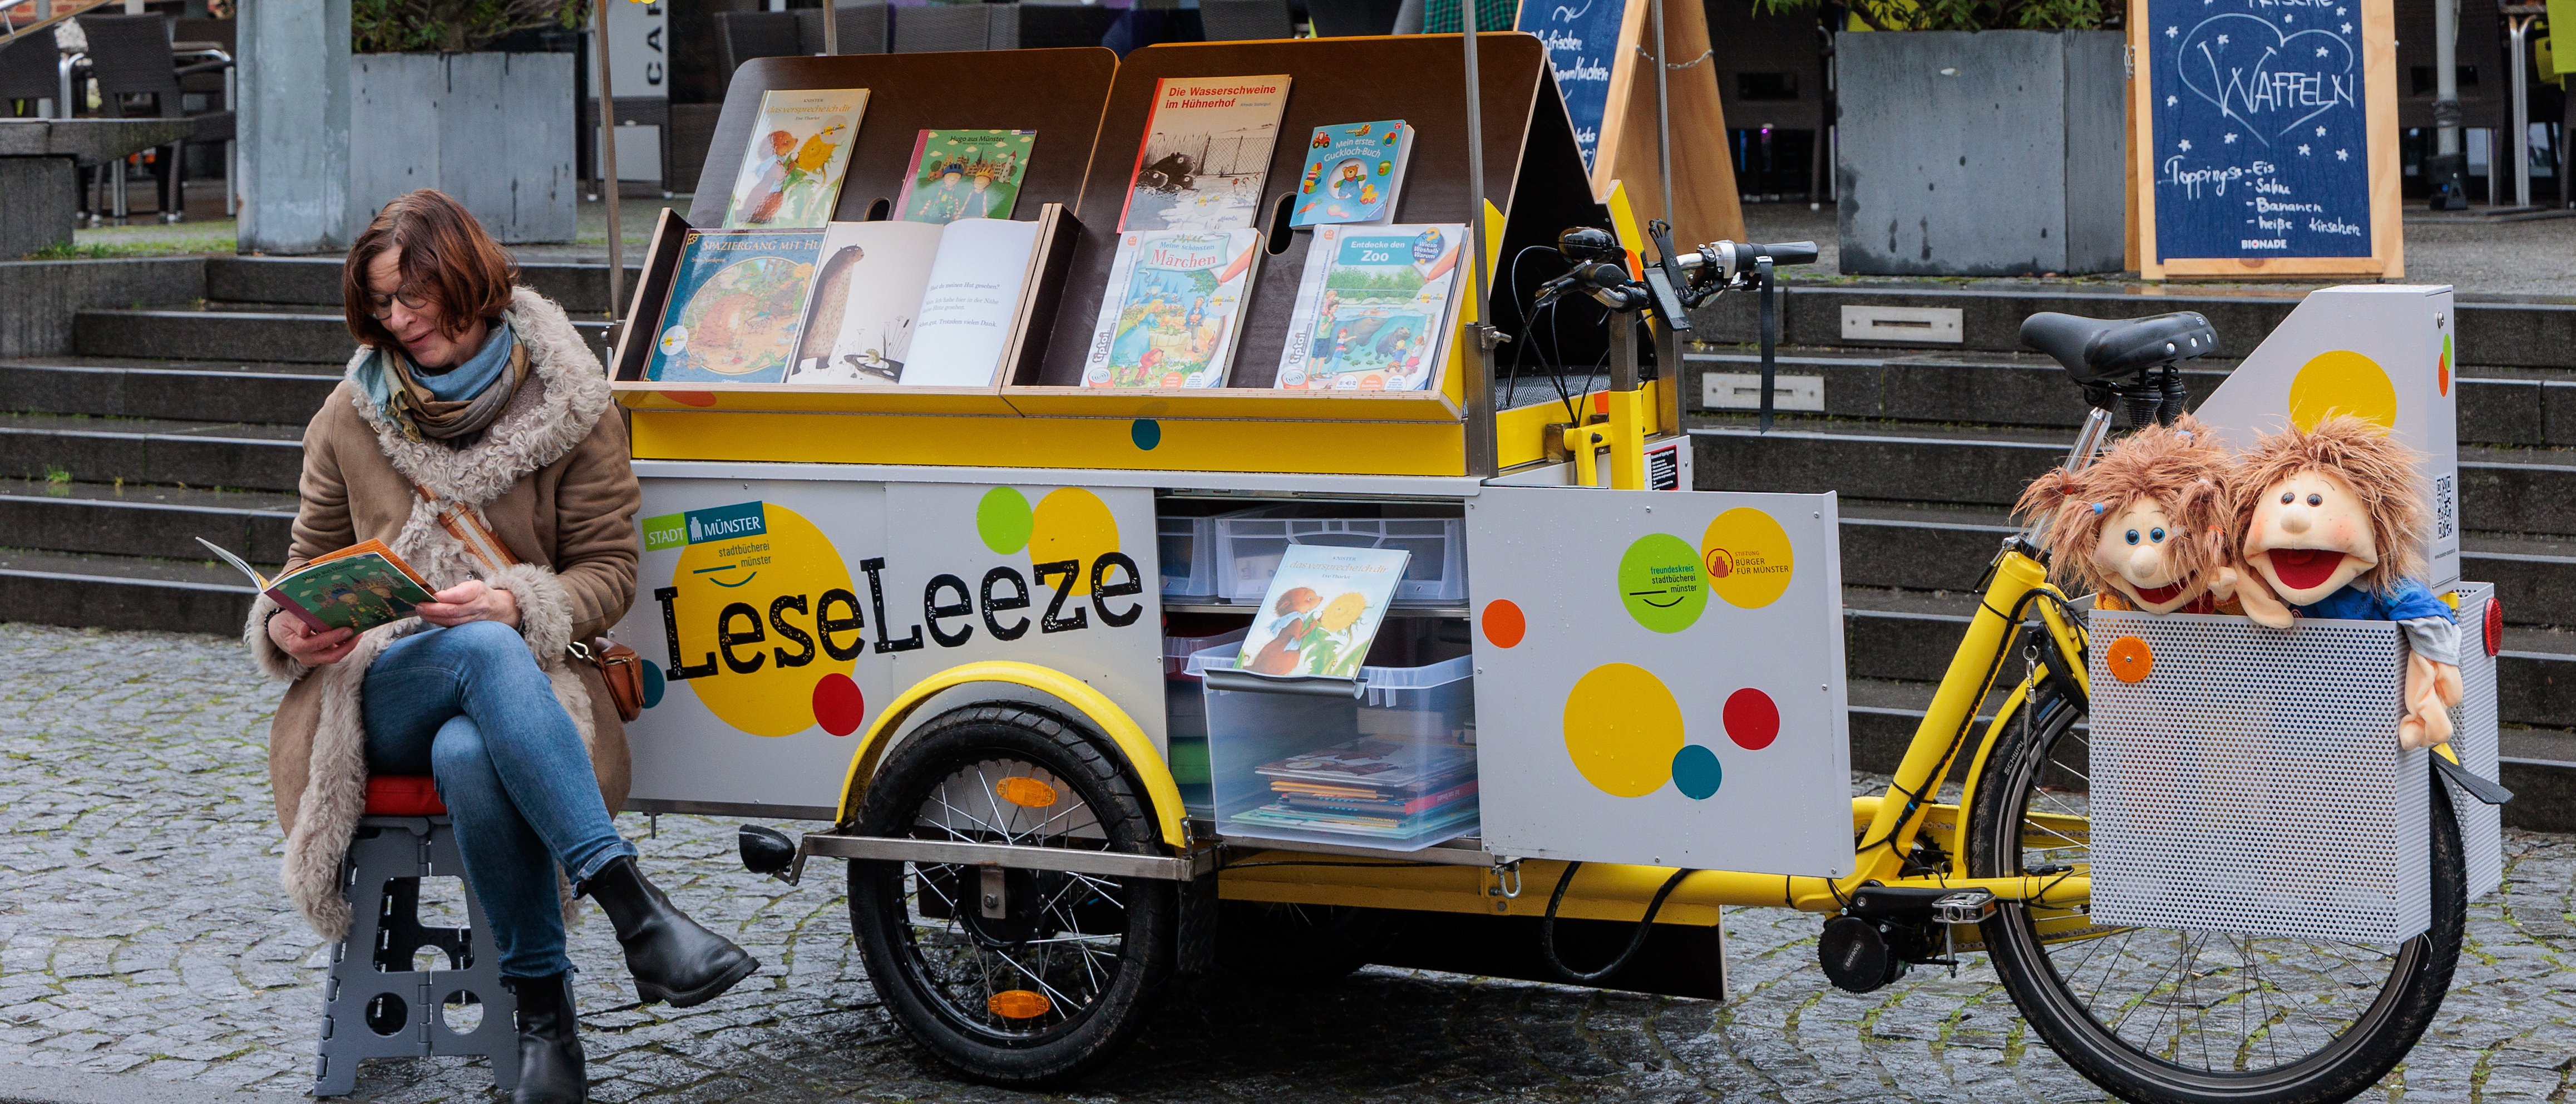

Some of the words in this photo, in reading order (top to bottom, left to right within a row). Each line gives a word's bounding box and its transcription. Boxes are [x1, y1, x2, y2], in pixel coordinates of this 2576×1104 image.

[2197, 41, 2355, 117] WAFFELN
[1169, 87, 1186, 96] Die
[1190, 85, 1276, 96] Wasserschweine
[1166, 100, 1178, 109] im
[1182, 98, 1236, 109] Hühnerhof
[783, 105, 826, 114] verspreche
[1336, 139, 1353, 149] Mein
[1324, 146, 1381, 162] Guckloch-Buch
[702, 240, 776, 250] SPAZIERGANG
[779, 241, 801, 250] MIT
[2241, 239, 2287, 249] BIONADE
[1149, 249, 1216, 268] Märchen
[1361, 250, 1389, 262] Zoo
[1092, 331, 1109, 362] tiptoi
[1290, 333, 1305, 363] tiptoi
[649, 528, 684, 545] STADT
[704, 516, 761, 536] MÜNSTER
[719, 540, 770, 557] stadtbücherei
[741, 555, 771, 567] münster
[1735, 557, 1765, 566] BÜRGER
[1309, 563, 1358, 571] verspreche
[1373, 565, 1388, 573] dir
[1651, 564, 1694, 574] freundeskreis
[1736, 566, 1751, 575] FÜR
[1753, 565, 1789, 574] MÜNSTER
[1652, 573, 1696, 584] stadtbücherei
[1671, 585, 1697, 593] münster
[654, 551, 1143, 682] LeseLeeze
[1845, 943, 1861, 967] BAFANG
